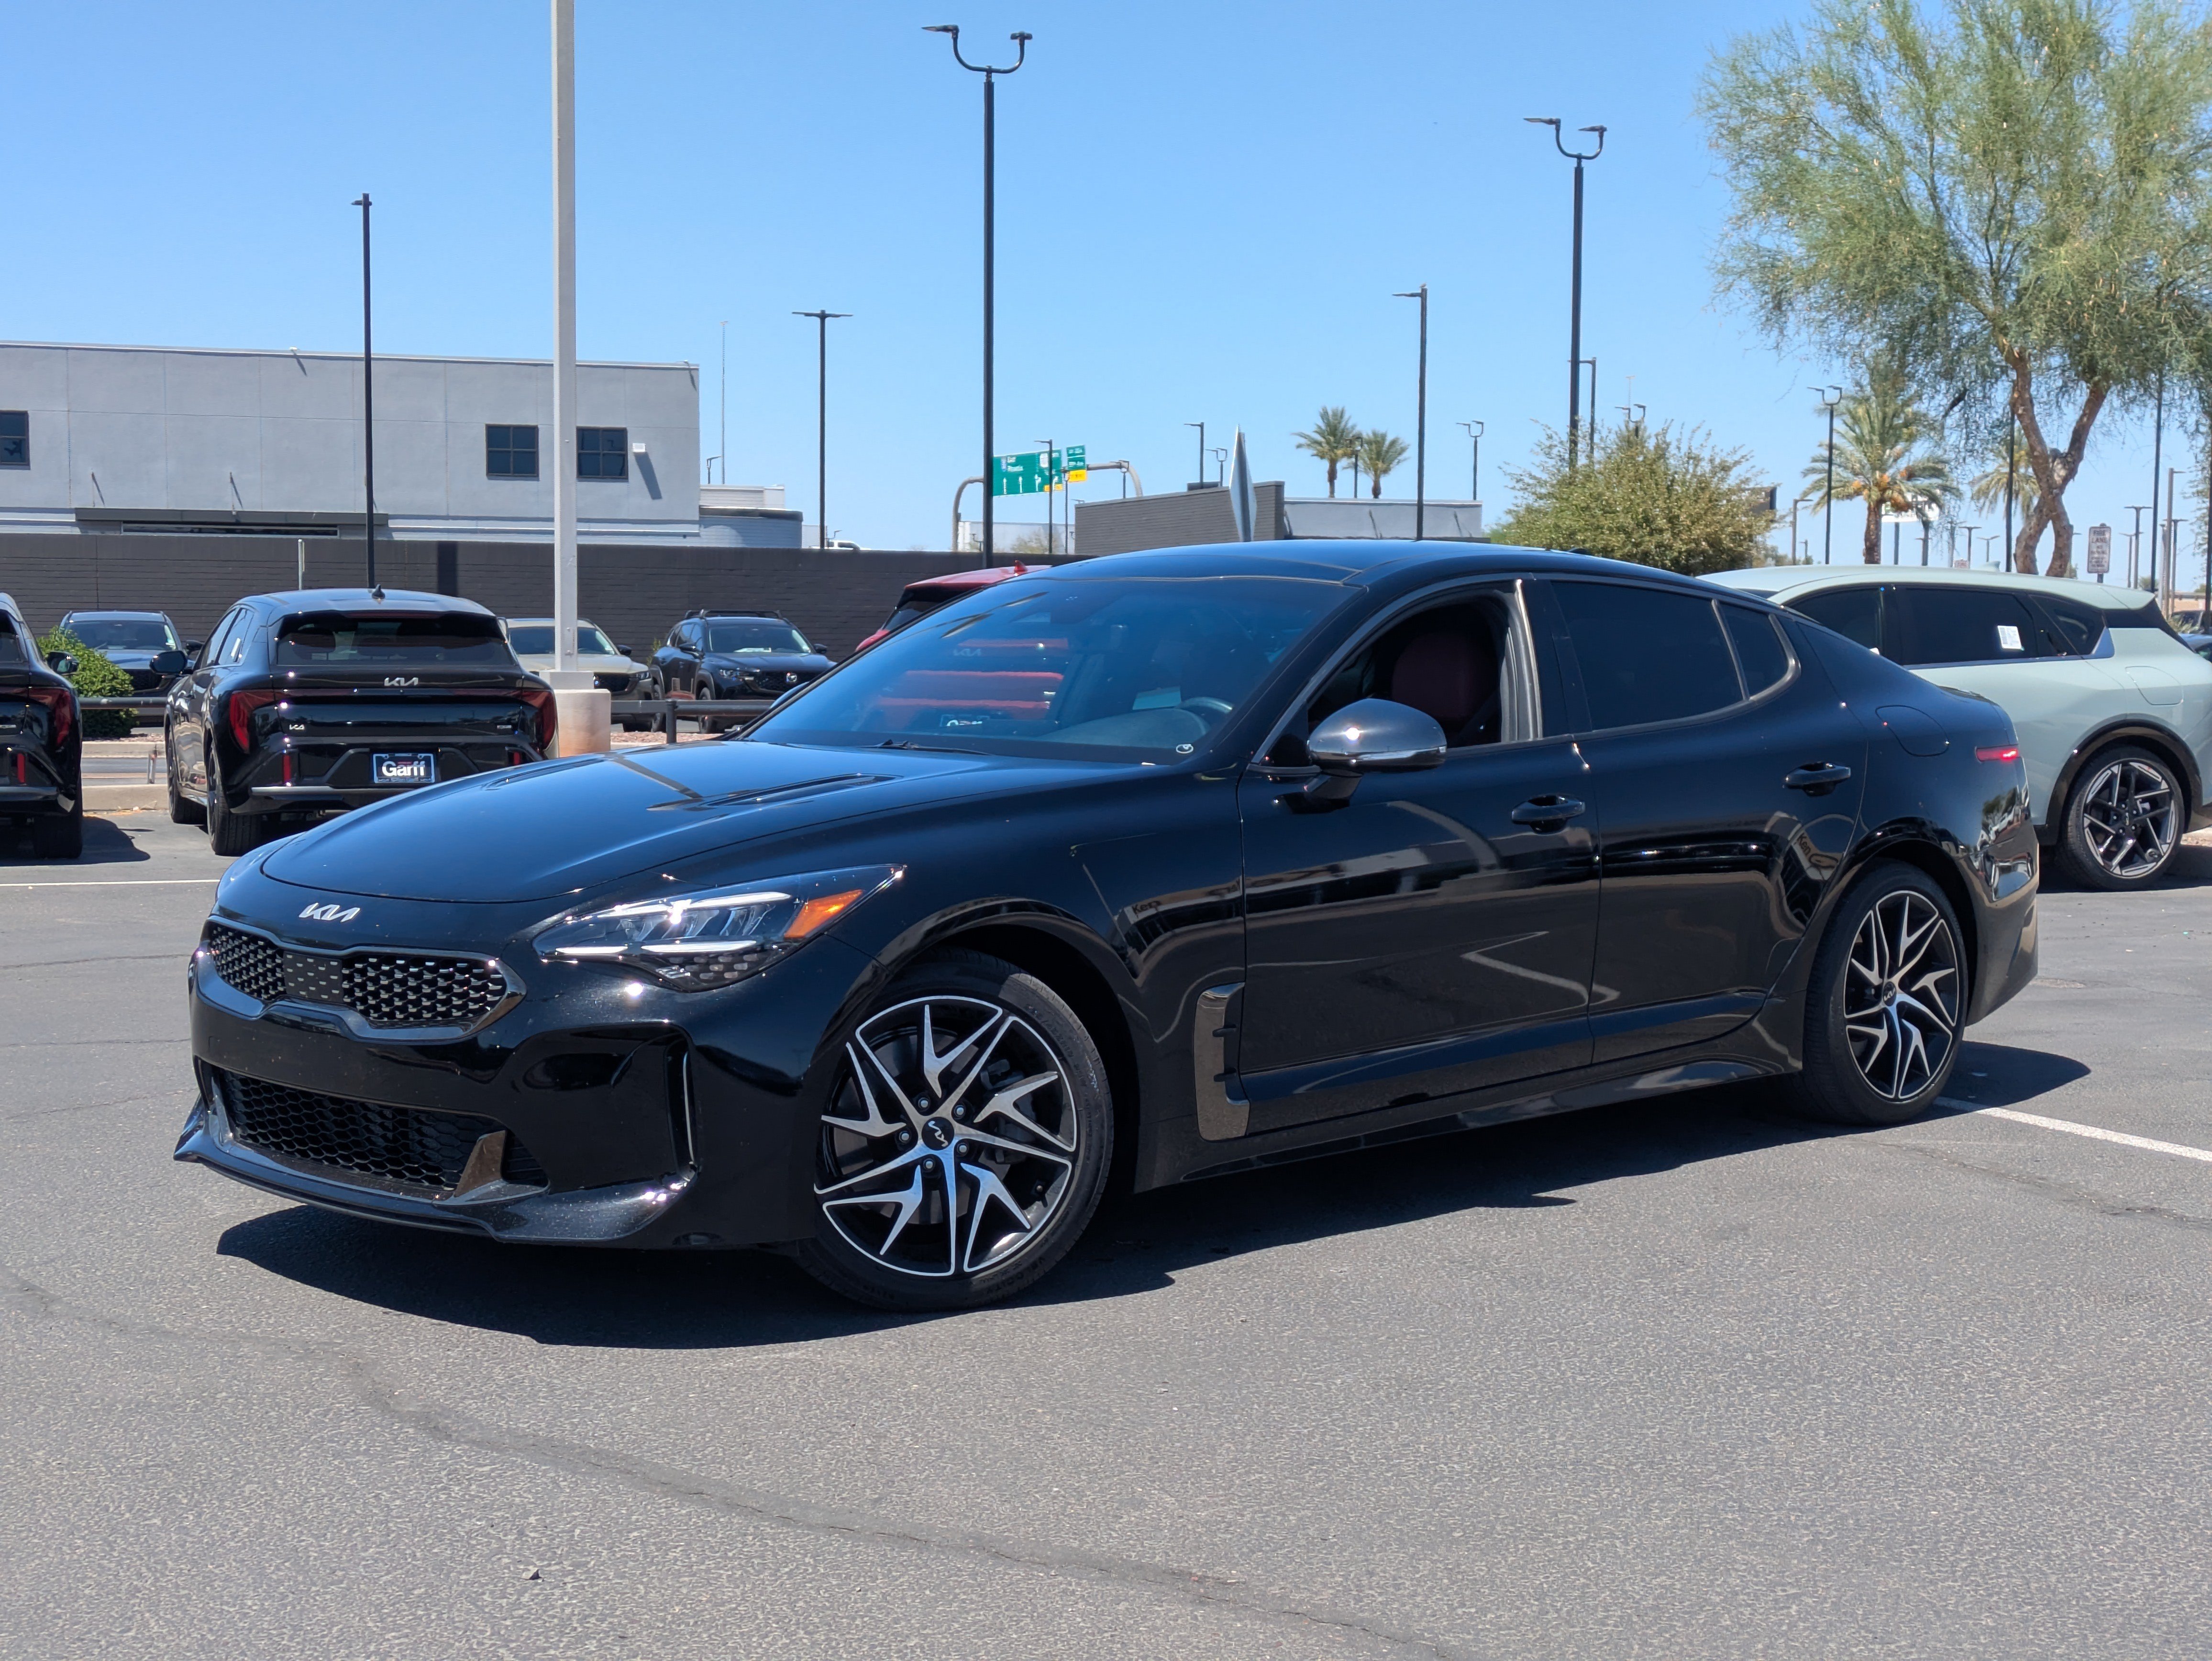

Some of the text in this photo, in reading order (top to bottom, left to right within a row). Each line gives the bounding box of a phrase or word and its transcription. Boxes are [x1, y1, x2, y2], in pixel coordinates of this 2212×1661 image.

[384, 677, 419, 686] KIA
[382, 761, 425, 776] Garff
[299, 902, 361, 922] KIA
